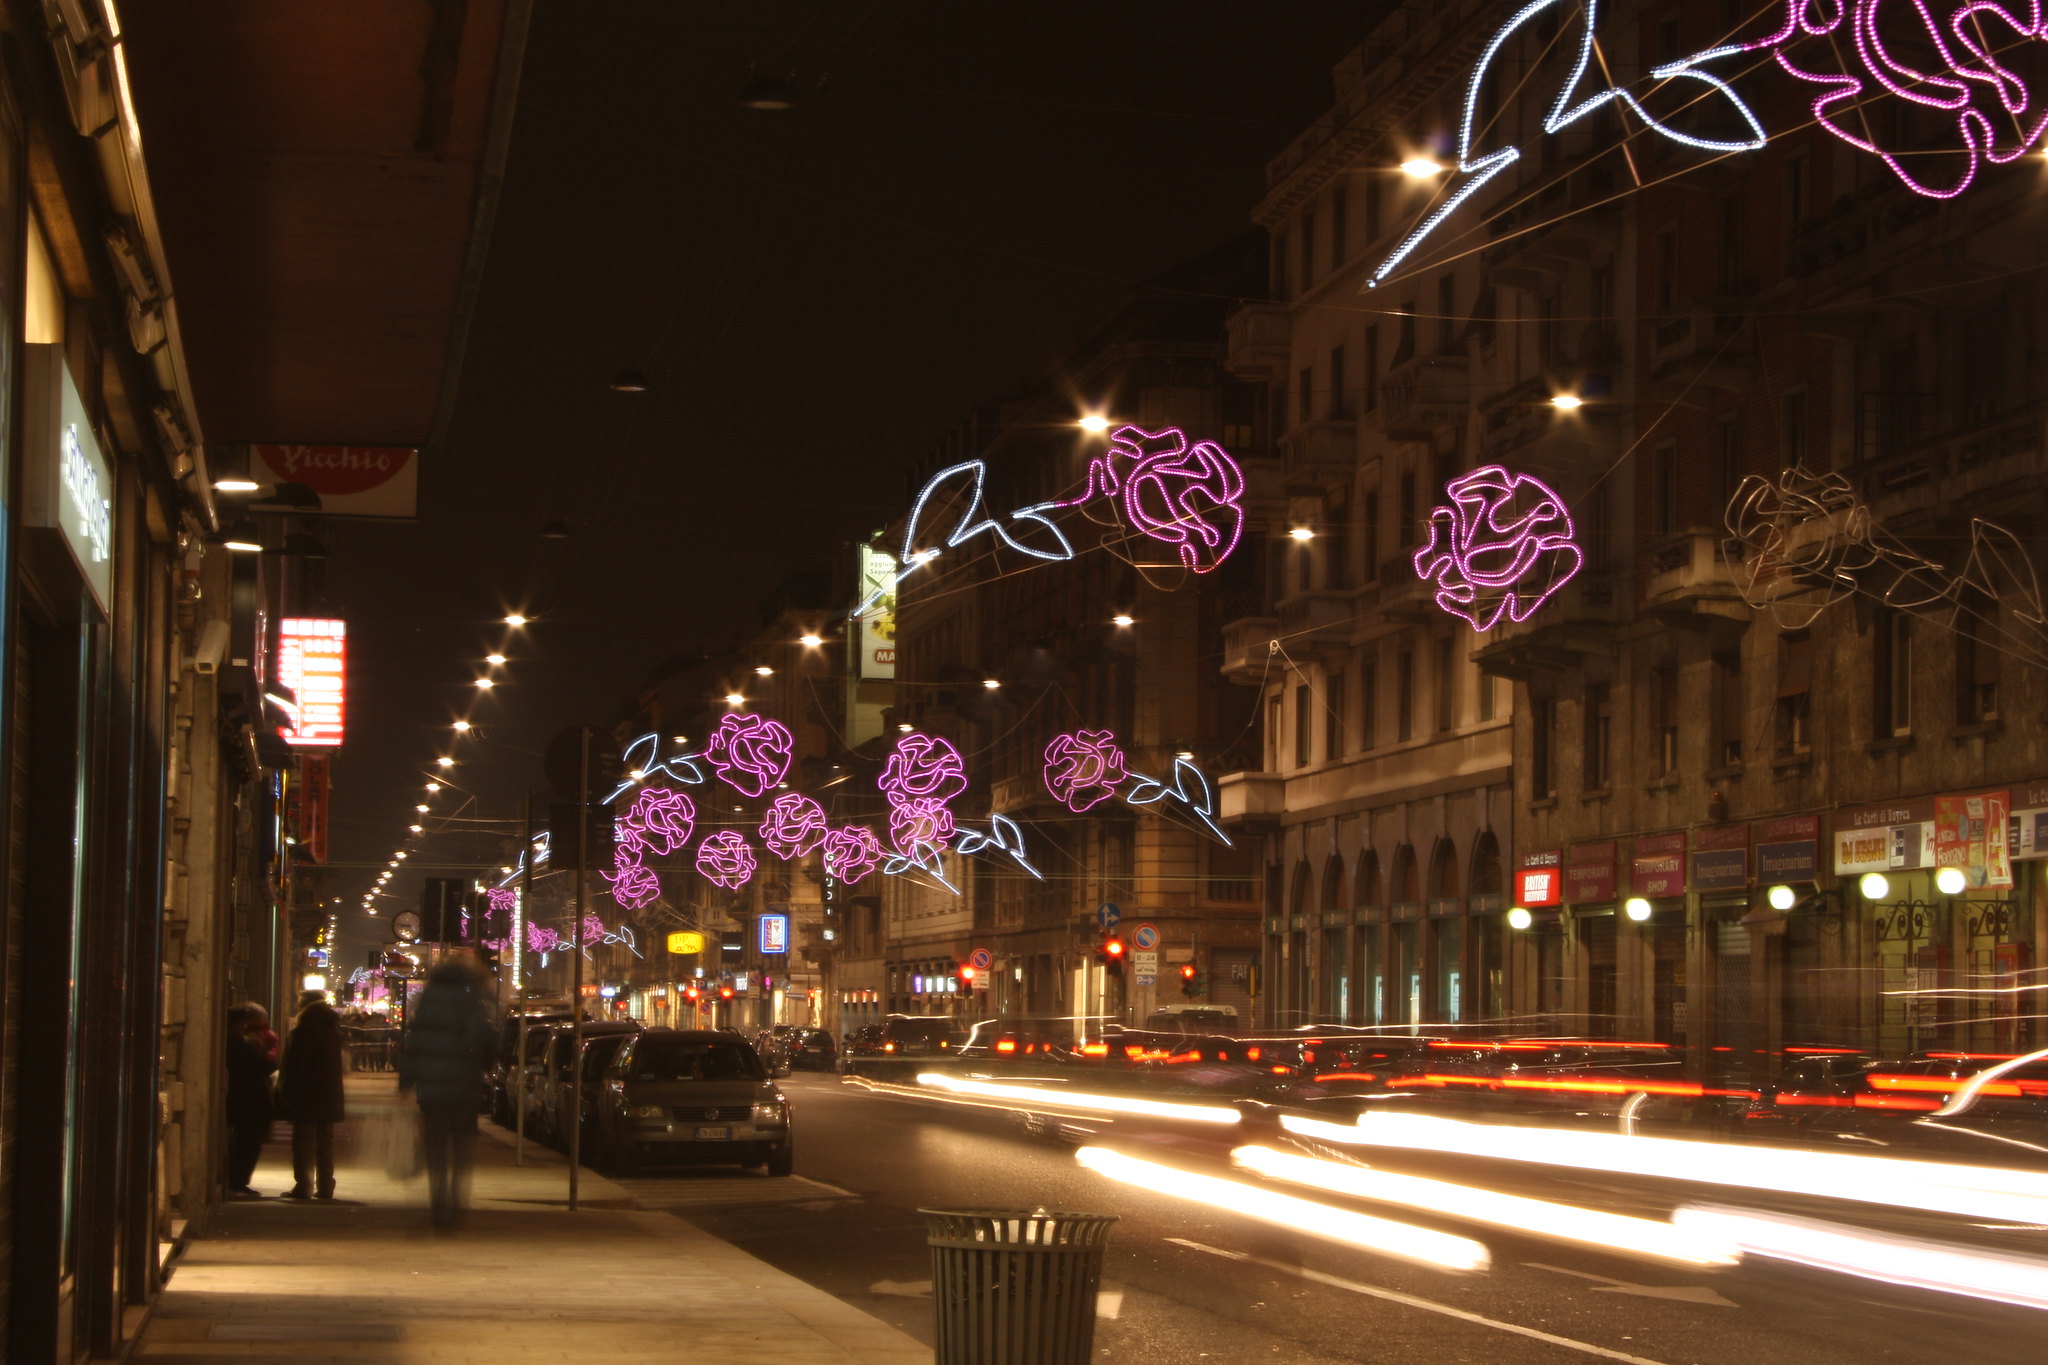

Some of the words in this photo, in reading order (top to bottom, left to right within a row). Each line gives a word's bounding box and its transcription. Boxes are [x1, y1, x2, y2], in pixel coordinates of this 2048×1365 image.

[1635, 859, 1680, 875] TEMPORARY
[1696, 860, 1743, 882] Imaginarium
[1762, 852, 1813, 876] Imaginarium
[1569, 866, 1610, 880] TEMPORARY
[1580, 886, 1599, 899] SHOP
[1647, 880, 1668, 893] SHOP
